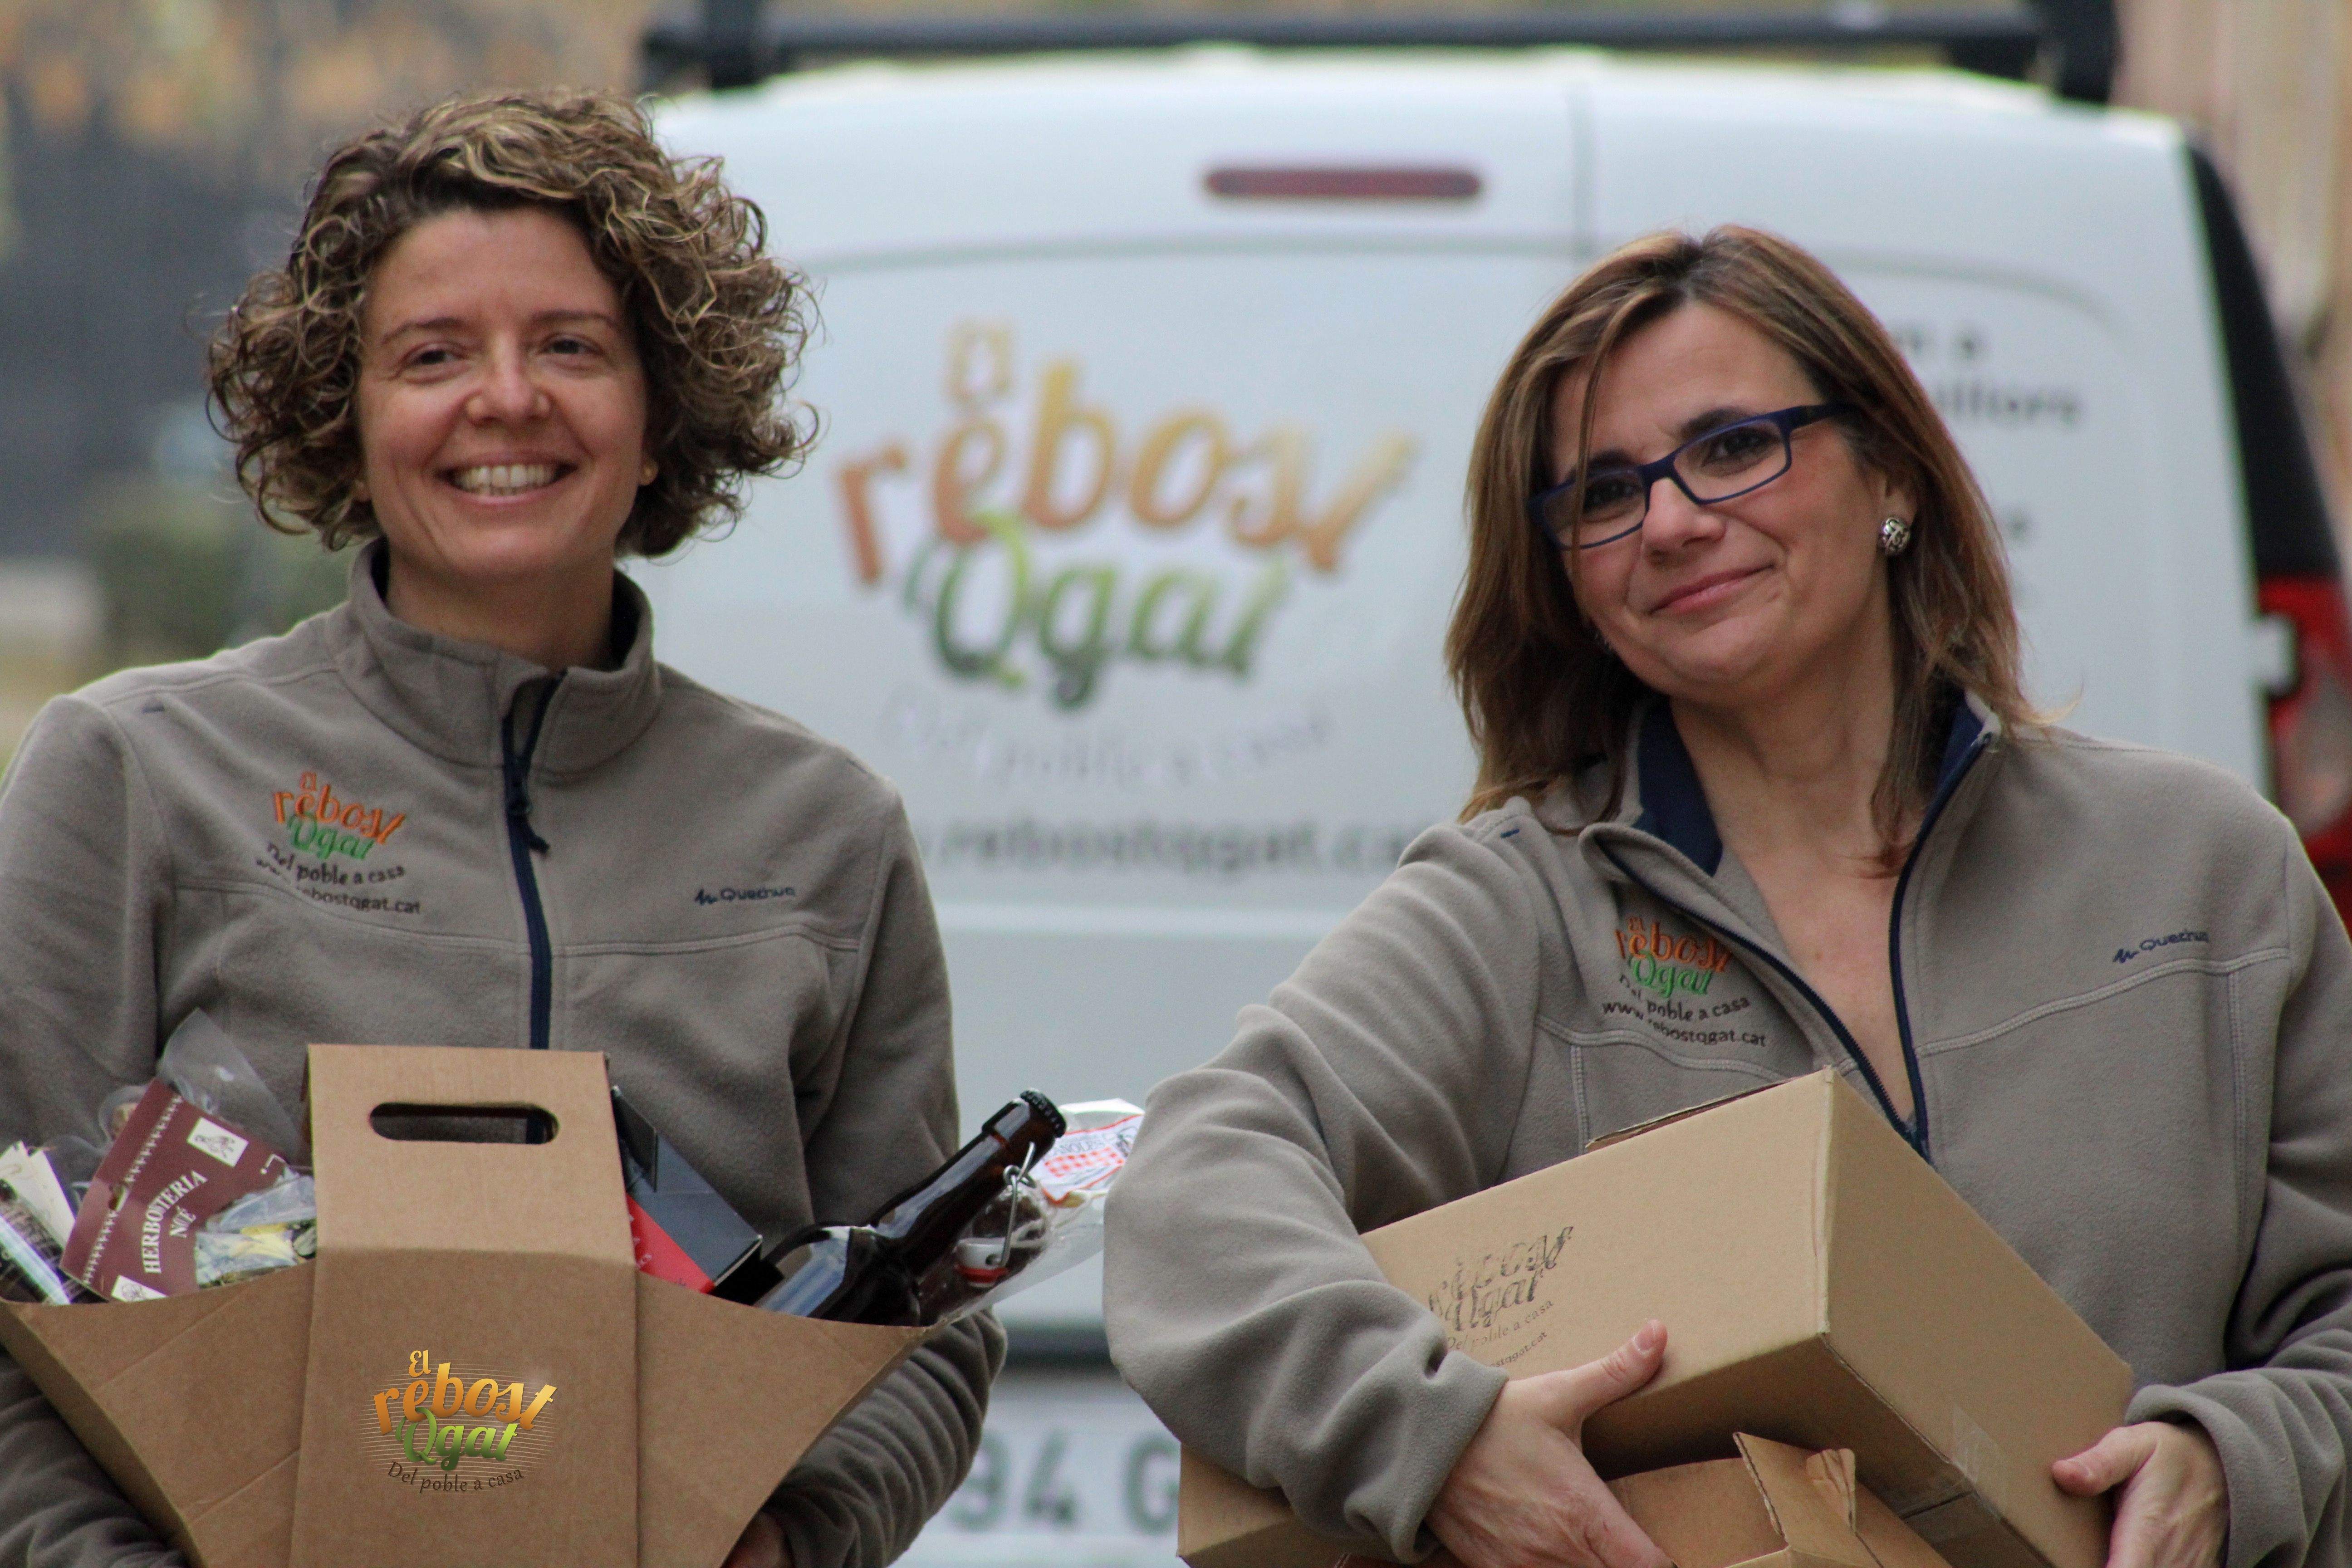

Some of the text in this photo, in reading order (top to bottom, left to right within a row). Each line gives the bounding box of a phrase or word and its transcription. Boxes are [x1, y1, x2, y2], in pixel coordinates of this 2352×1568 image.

[831, 358, 1423, 585] rebost
[274, 784, 406, 846] rebost
[296, 862, 348, 885] poble
[353, 872, 364, 885] a
[368, 864, 405, 884] casa
[1646, 999, 1694, 1022] poble
[1698, 1008, 1709, 1021] a
[1712, 998, 1750, 1018] casa
[1513, 1321, 1522, 1332] a
[1524, 1299, 1555, 1325] casa
[408, 1349, 432, 1378] El
[373, 1362, 558, 1435] rebost
[394, 1406, 519, 1471] Qgat
[387, 1460, 525, 1494] Del poble a casa
